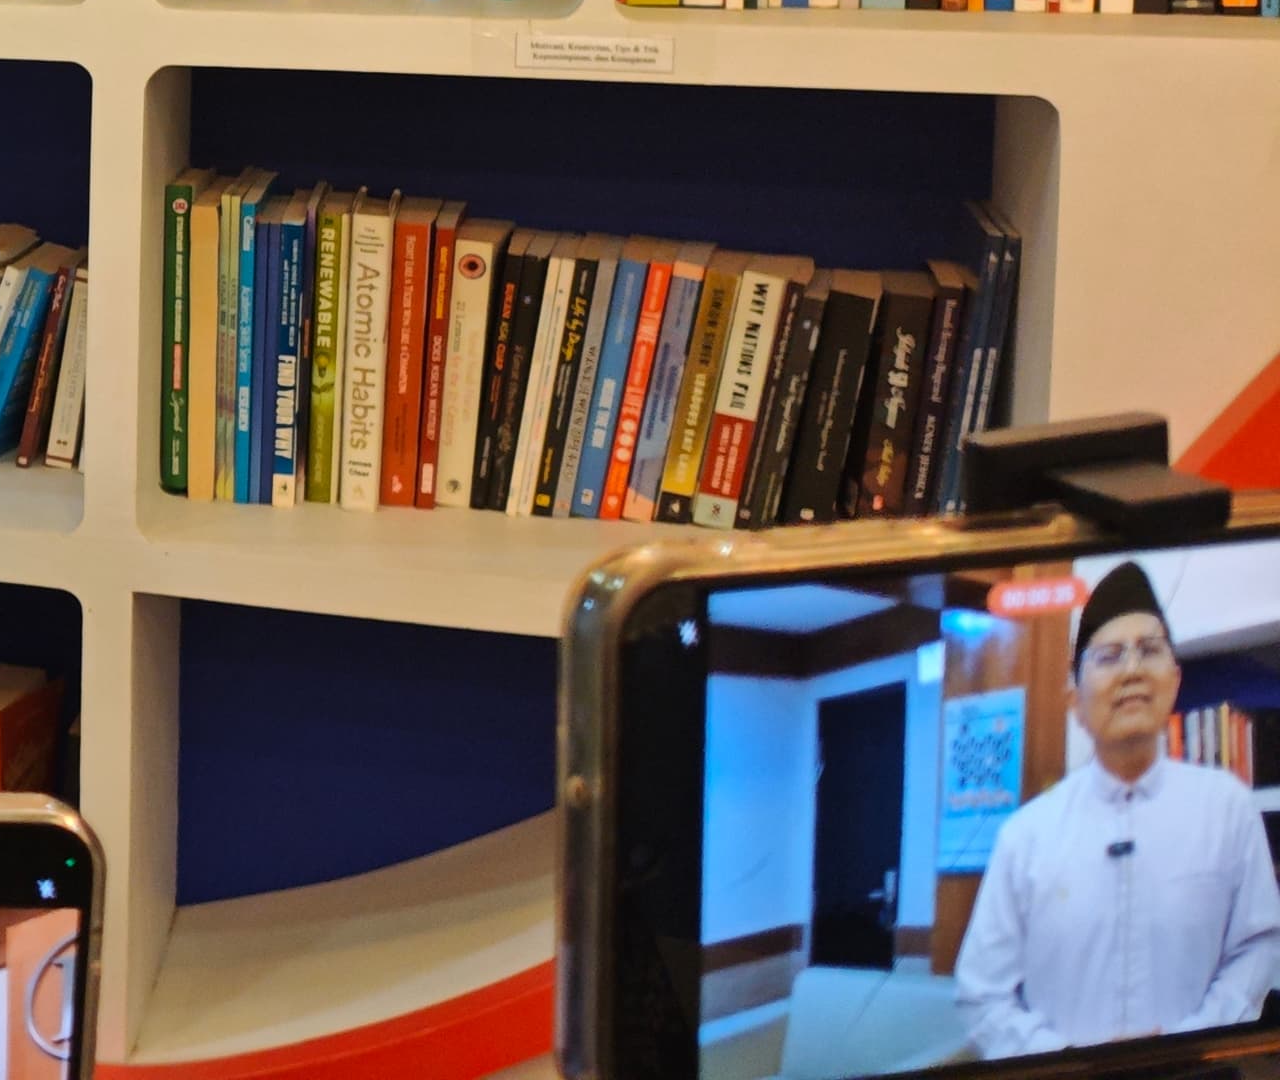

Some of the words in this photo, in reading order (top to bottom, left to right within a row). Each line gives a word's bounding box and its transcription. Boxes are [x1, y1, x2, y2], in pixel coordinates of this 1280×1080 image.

[314, 227, 337, 347] RENEWABLE
[354, 262, 378, 358] Atomic
[277, 354, 295, 386] FIND
[275, 389, 293, 425] YOUR
[350, 367, 376, 449] Habits
[274, 426, 292, 459] WHY
